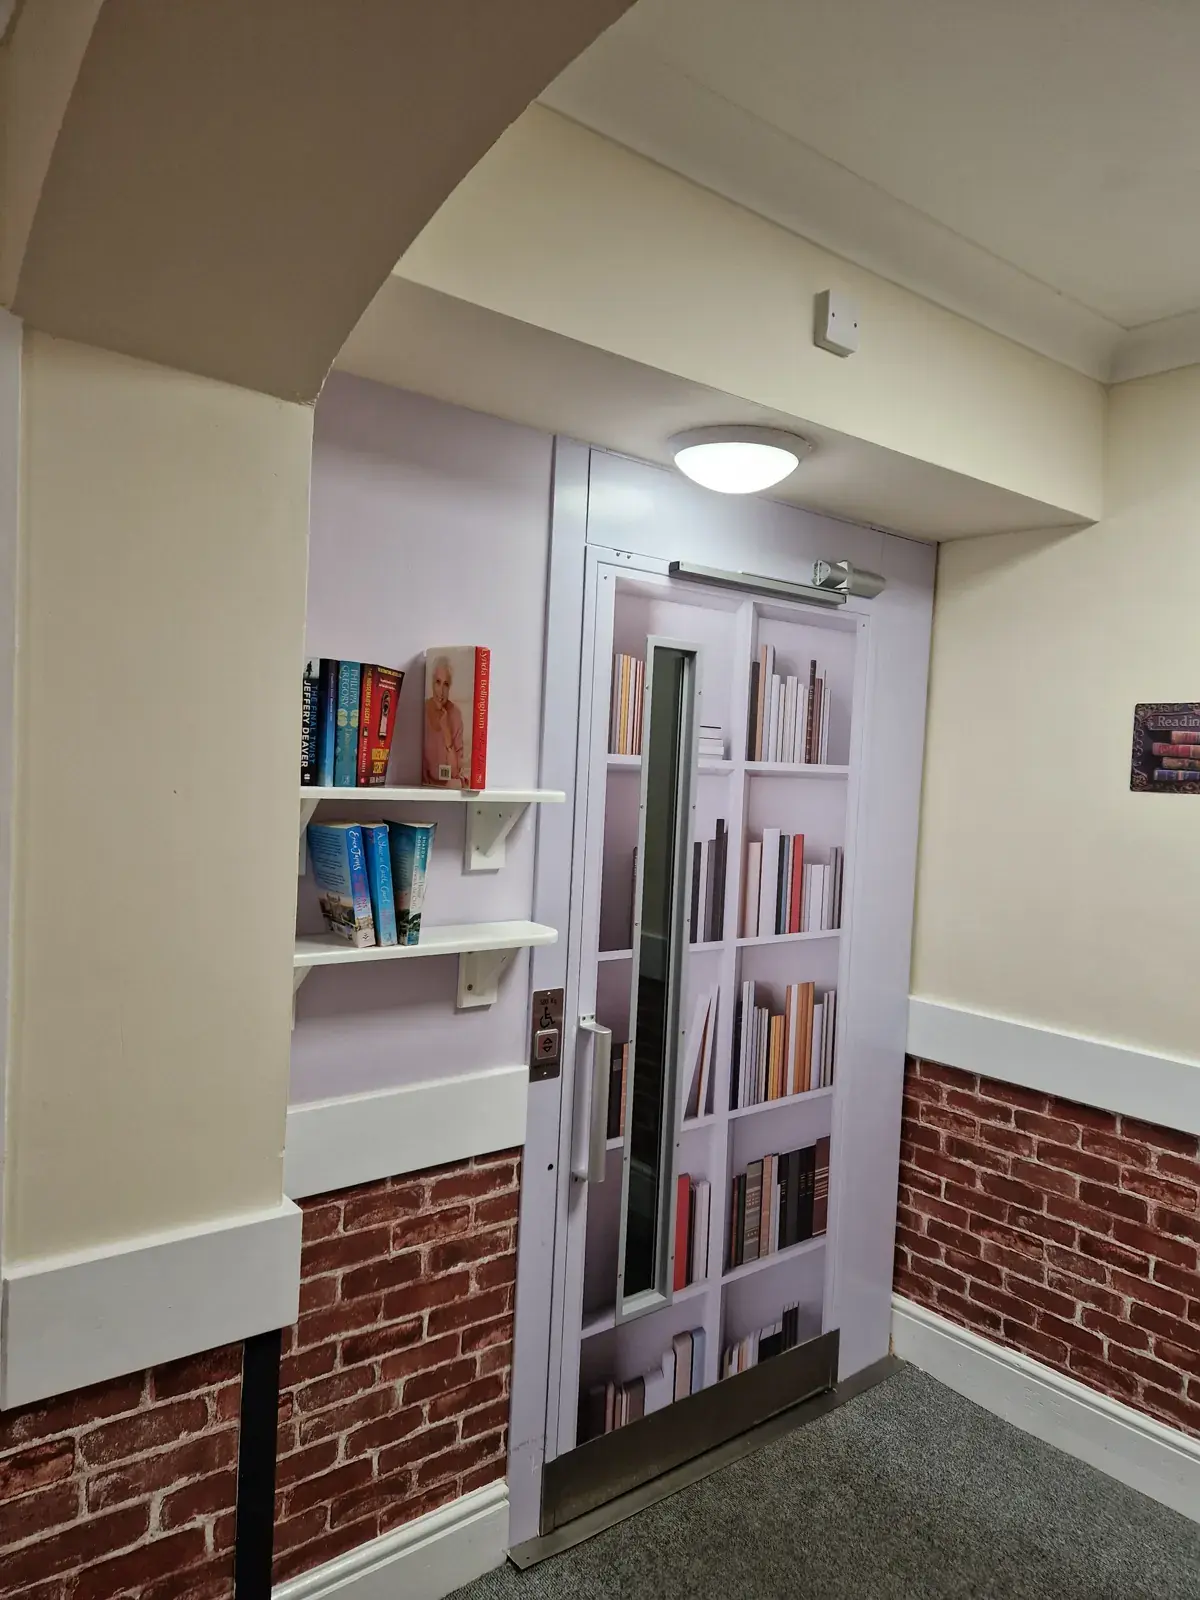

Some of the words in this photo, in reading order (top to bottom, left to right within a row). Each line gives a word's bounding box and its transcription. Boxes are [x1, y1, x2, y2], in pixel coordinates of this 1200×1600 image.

[479, 648, 489, 676] Lynda
[310, 685, 318, 702] THE
[340, 665, 350, 707] GREGORY
[349, 669, 359, 704] PHILIPPA
[302, 680, 312, 726] JEFFERY
[477, 679, 488, 729] Bellingham
[309, 705, 317, 733] FINAL
[363, 707, 371, 725] SECRET
[301, 727, 310, 768] DEAVER
[308, 736, 316, 764] TWIST
[348, 830, 360, 849] Erica
[377, 832, 384, 840] A
[377, 841, 386, 856] Year
[350, 848, 362, 871] James
[379, 864, 389, 885] Castle
[379, 885, 390, 905] Court
